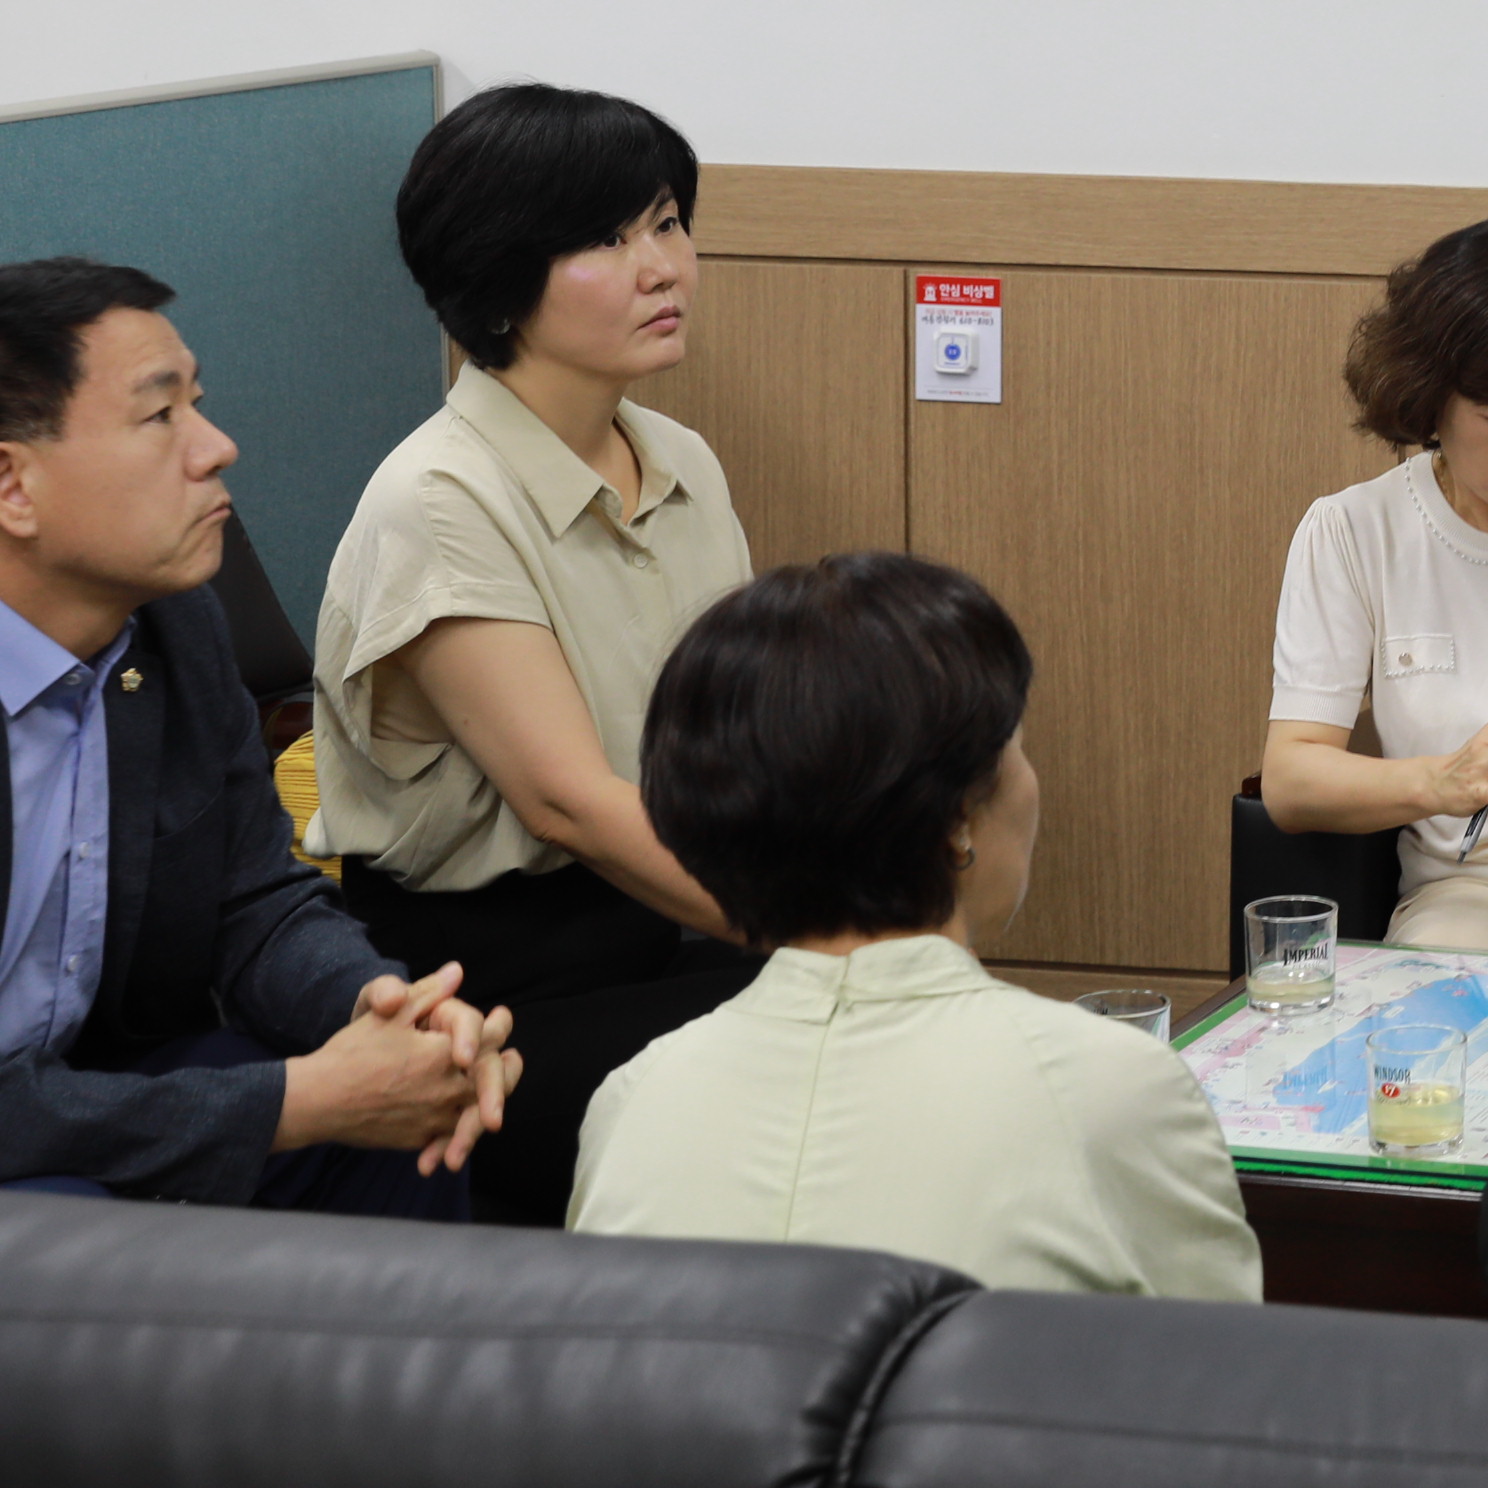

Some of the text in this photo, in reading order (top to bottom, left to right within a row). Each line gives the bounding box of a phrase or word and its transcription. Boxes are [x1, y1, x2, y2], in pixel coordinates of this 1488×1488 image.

[939, 283, 995, 299] 안심 비상벨
[1283, 943, 1328, 967] IMPERIAL
[1374, 1064, 1411, 1084] WINDSOR
